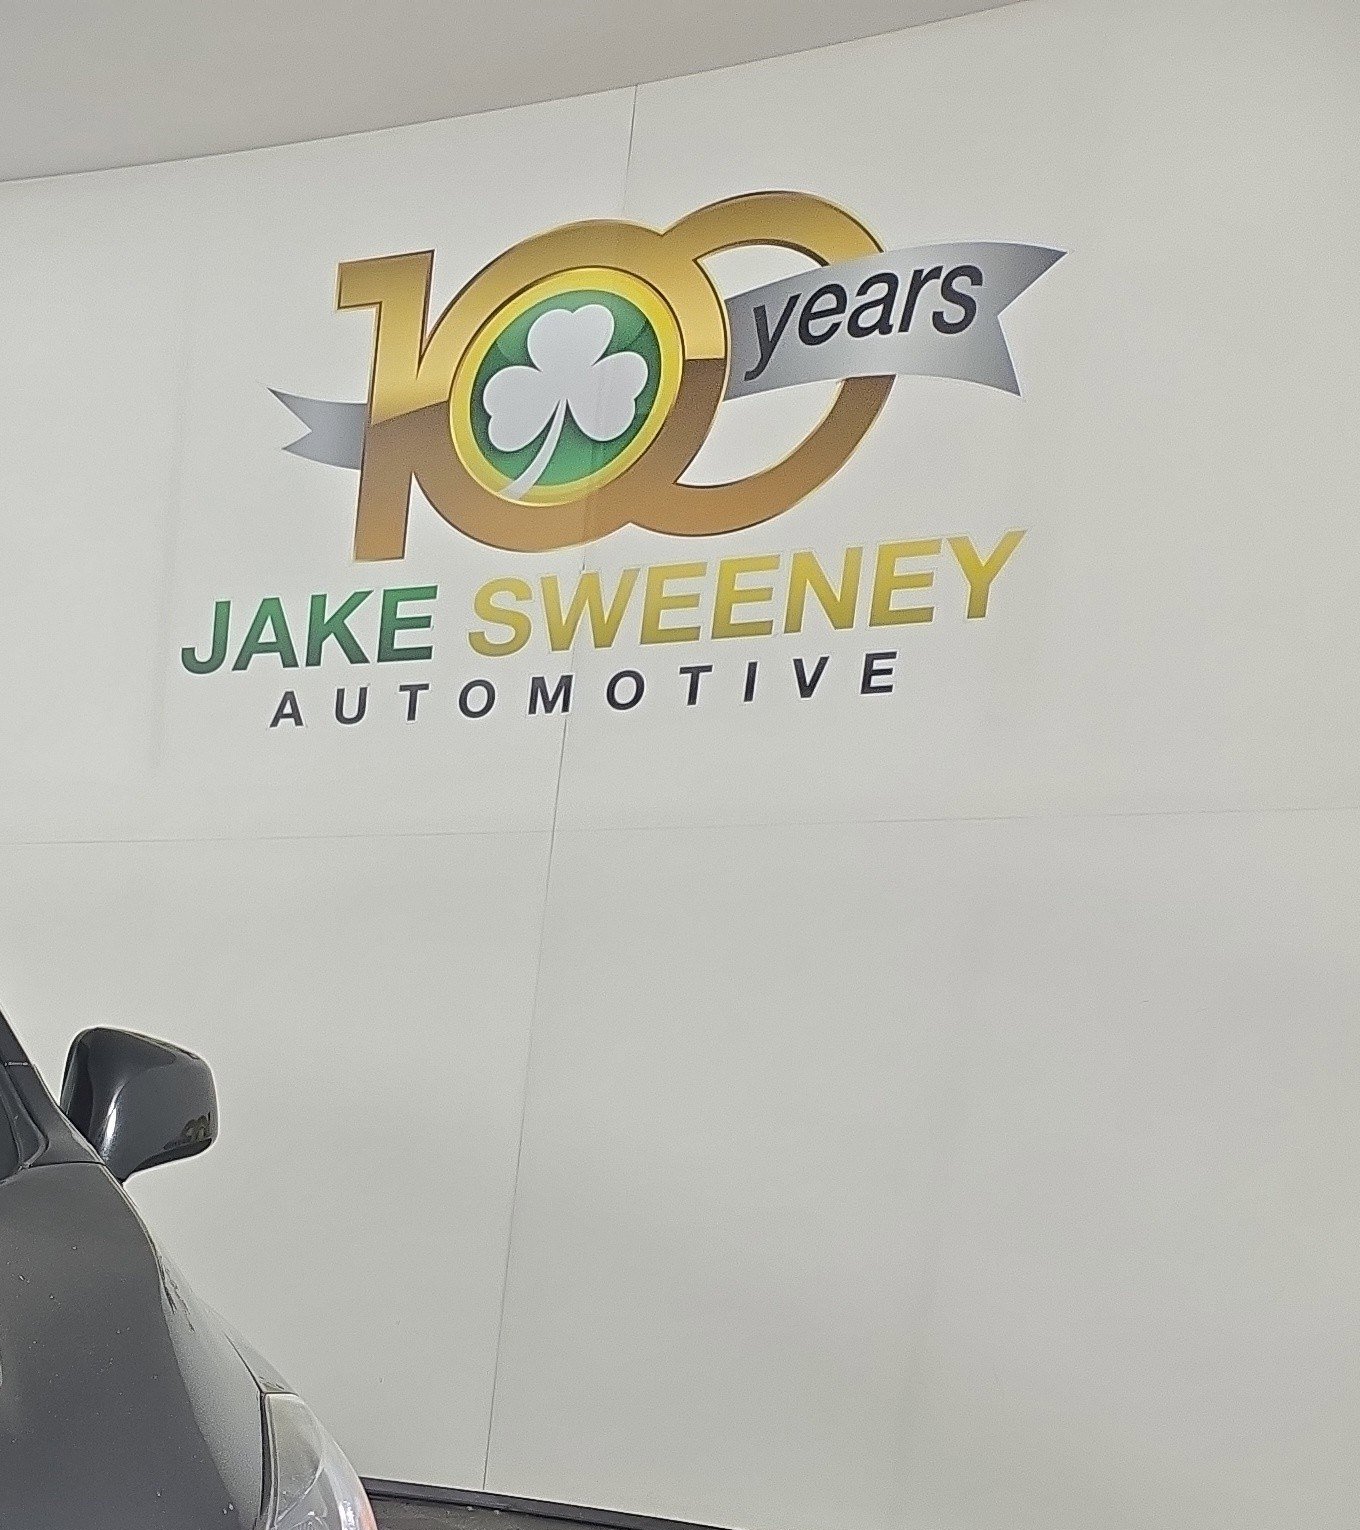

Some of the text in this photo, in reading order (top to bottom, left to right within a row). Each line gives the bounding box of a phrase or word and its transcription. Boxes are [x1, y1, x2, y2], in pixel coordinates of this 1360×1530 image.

[744, 264, 982, 380] years
[180, 530, 1025, 674] JAKE SWEENEY
[269, 652, 897, 728] AUTOMOTIVE
